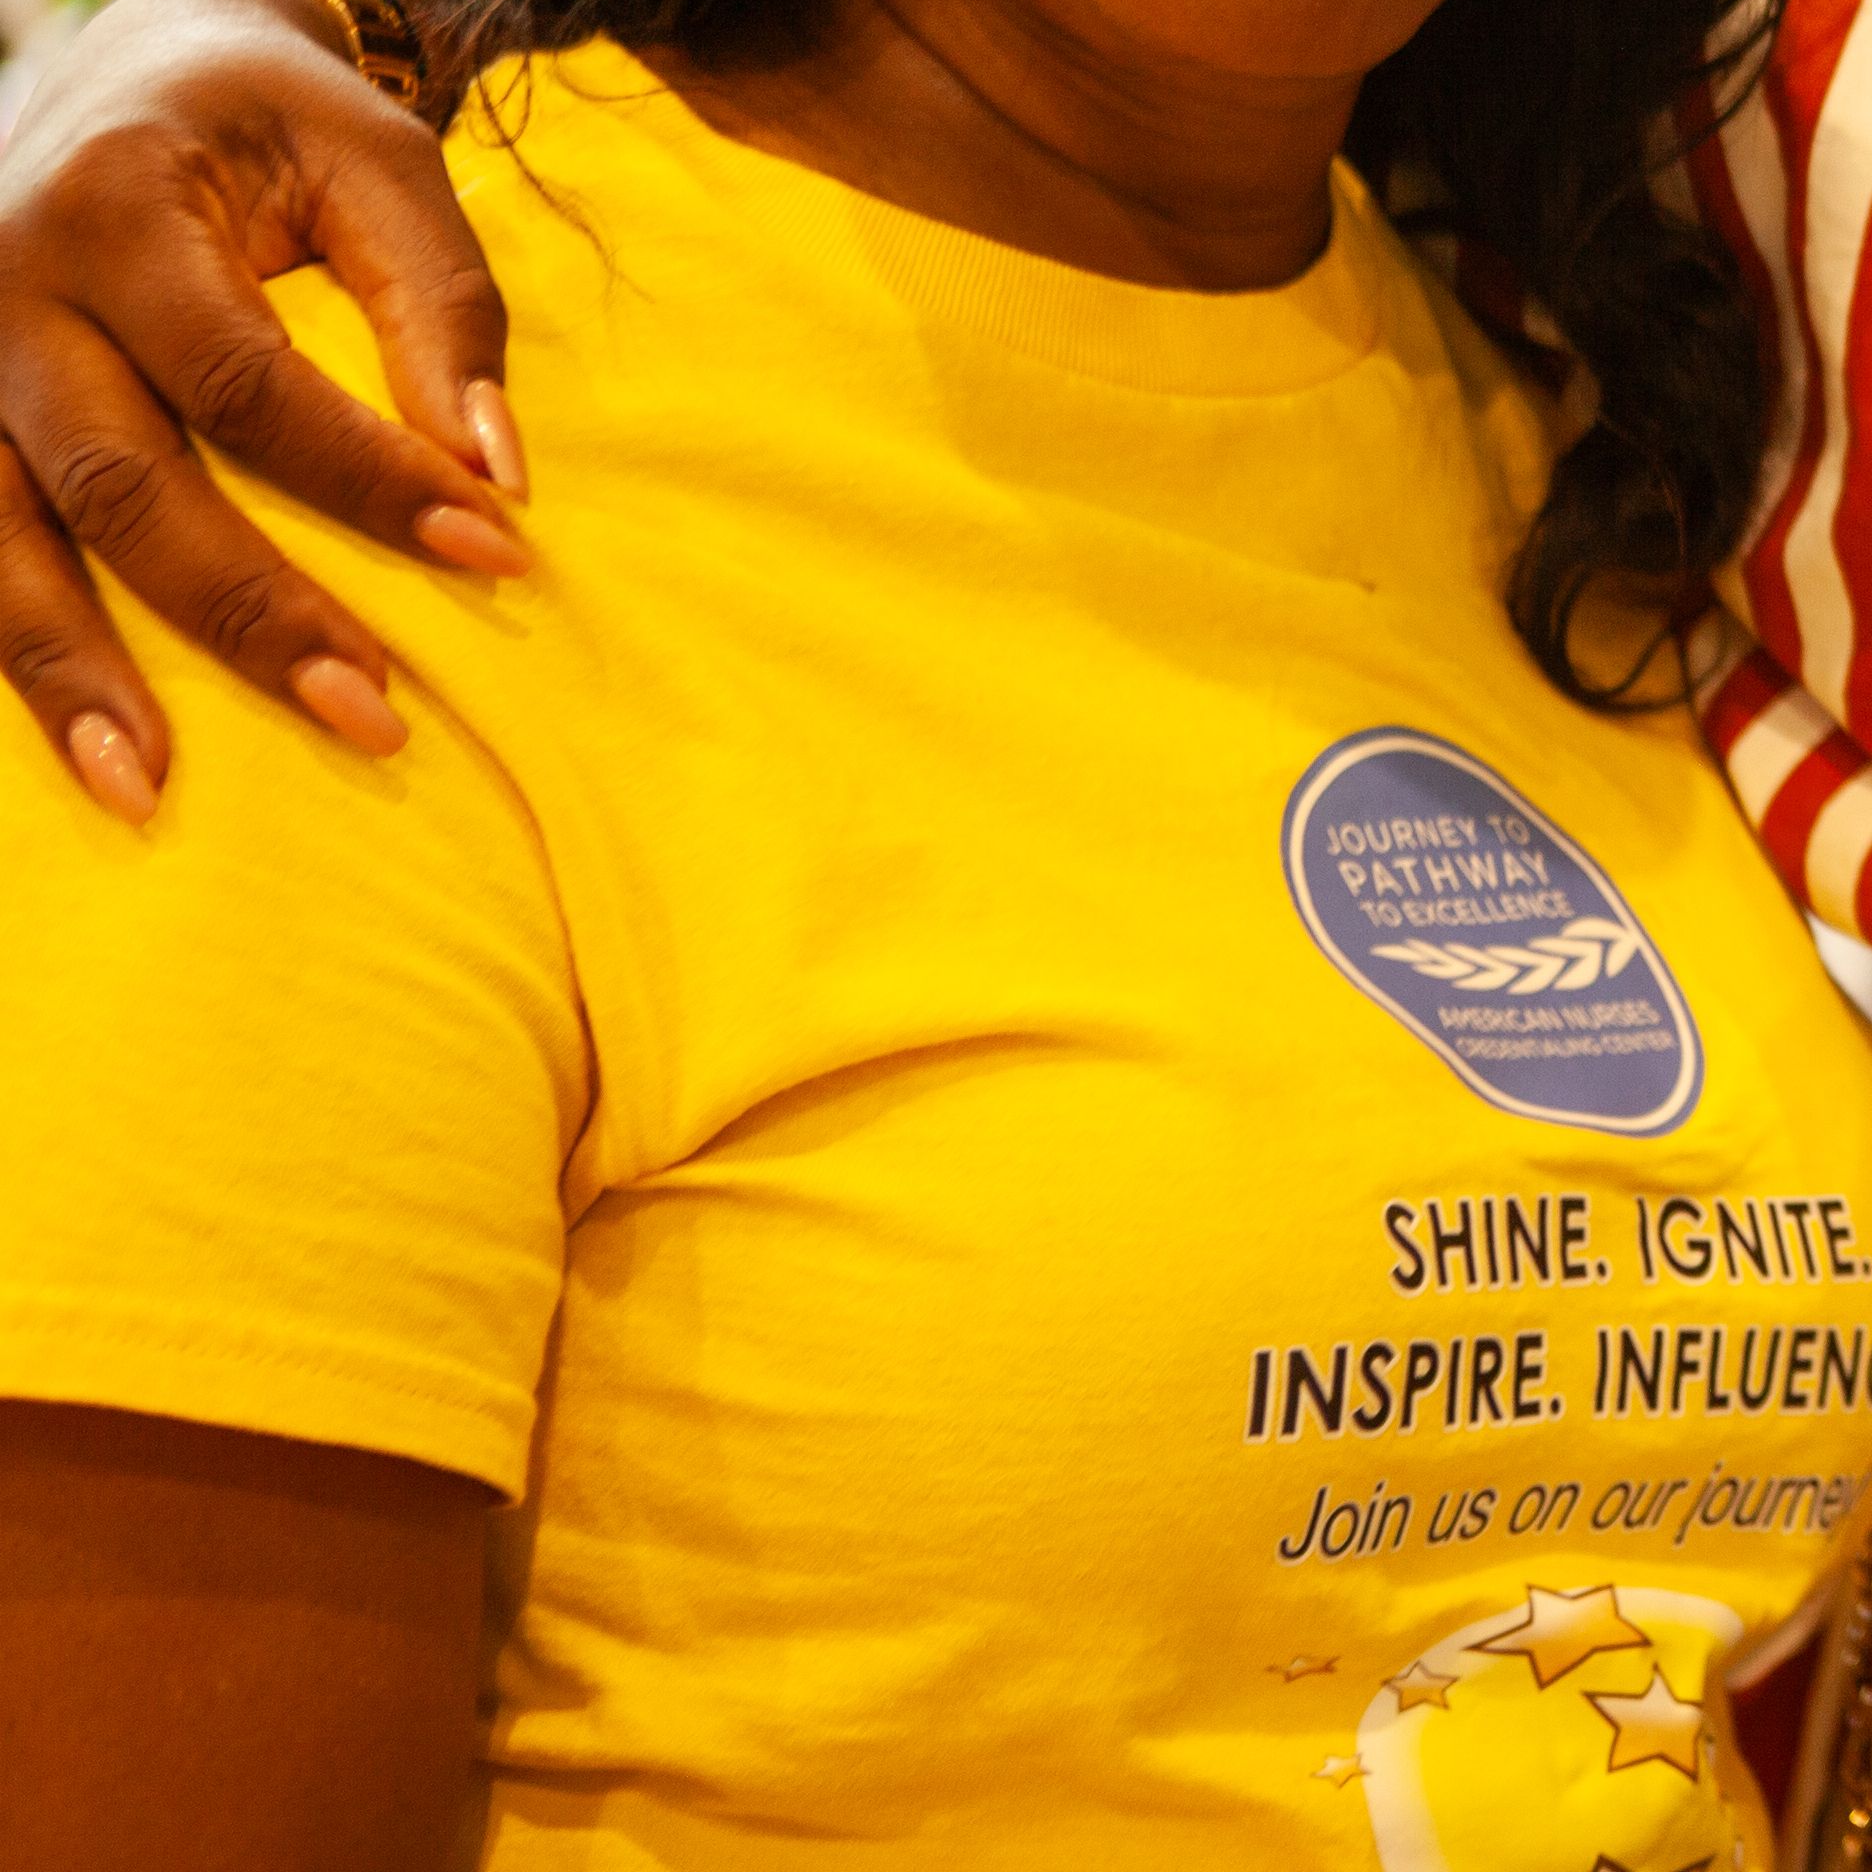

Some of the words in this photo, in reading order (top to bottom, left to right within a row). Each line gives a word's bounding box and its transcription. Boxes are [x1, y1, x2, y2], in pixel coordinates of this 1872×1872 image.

[1326, 815, 1478, 856] JOURNEY
[1486, 812, 1531, 846] TO
[1337, 850, 1550, 898] PATHWAY
[1359, 899, 1403, 928] TO
[1402, 888, 1576, 927] EXCELLENCE
[1437, 1006, 1566, 1032] AMERICAN
[1561, 999, 1662, 1031] NURSES
[1384, 1195, 1609, 1290] SHINE.
[1247, 1332, 1563, 1438] INSPIRE.
[1278, 1480, 1412, 1562] Join
[1426, 1486, 1497, 1545] us
[1508, 1481, 1582, 1536] on
[1590, 1478, 1692, 1530] our
